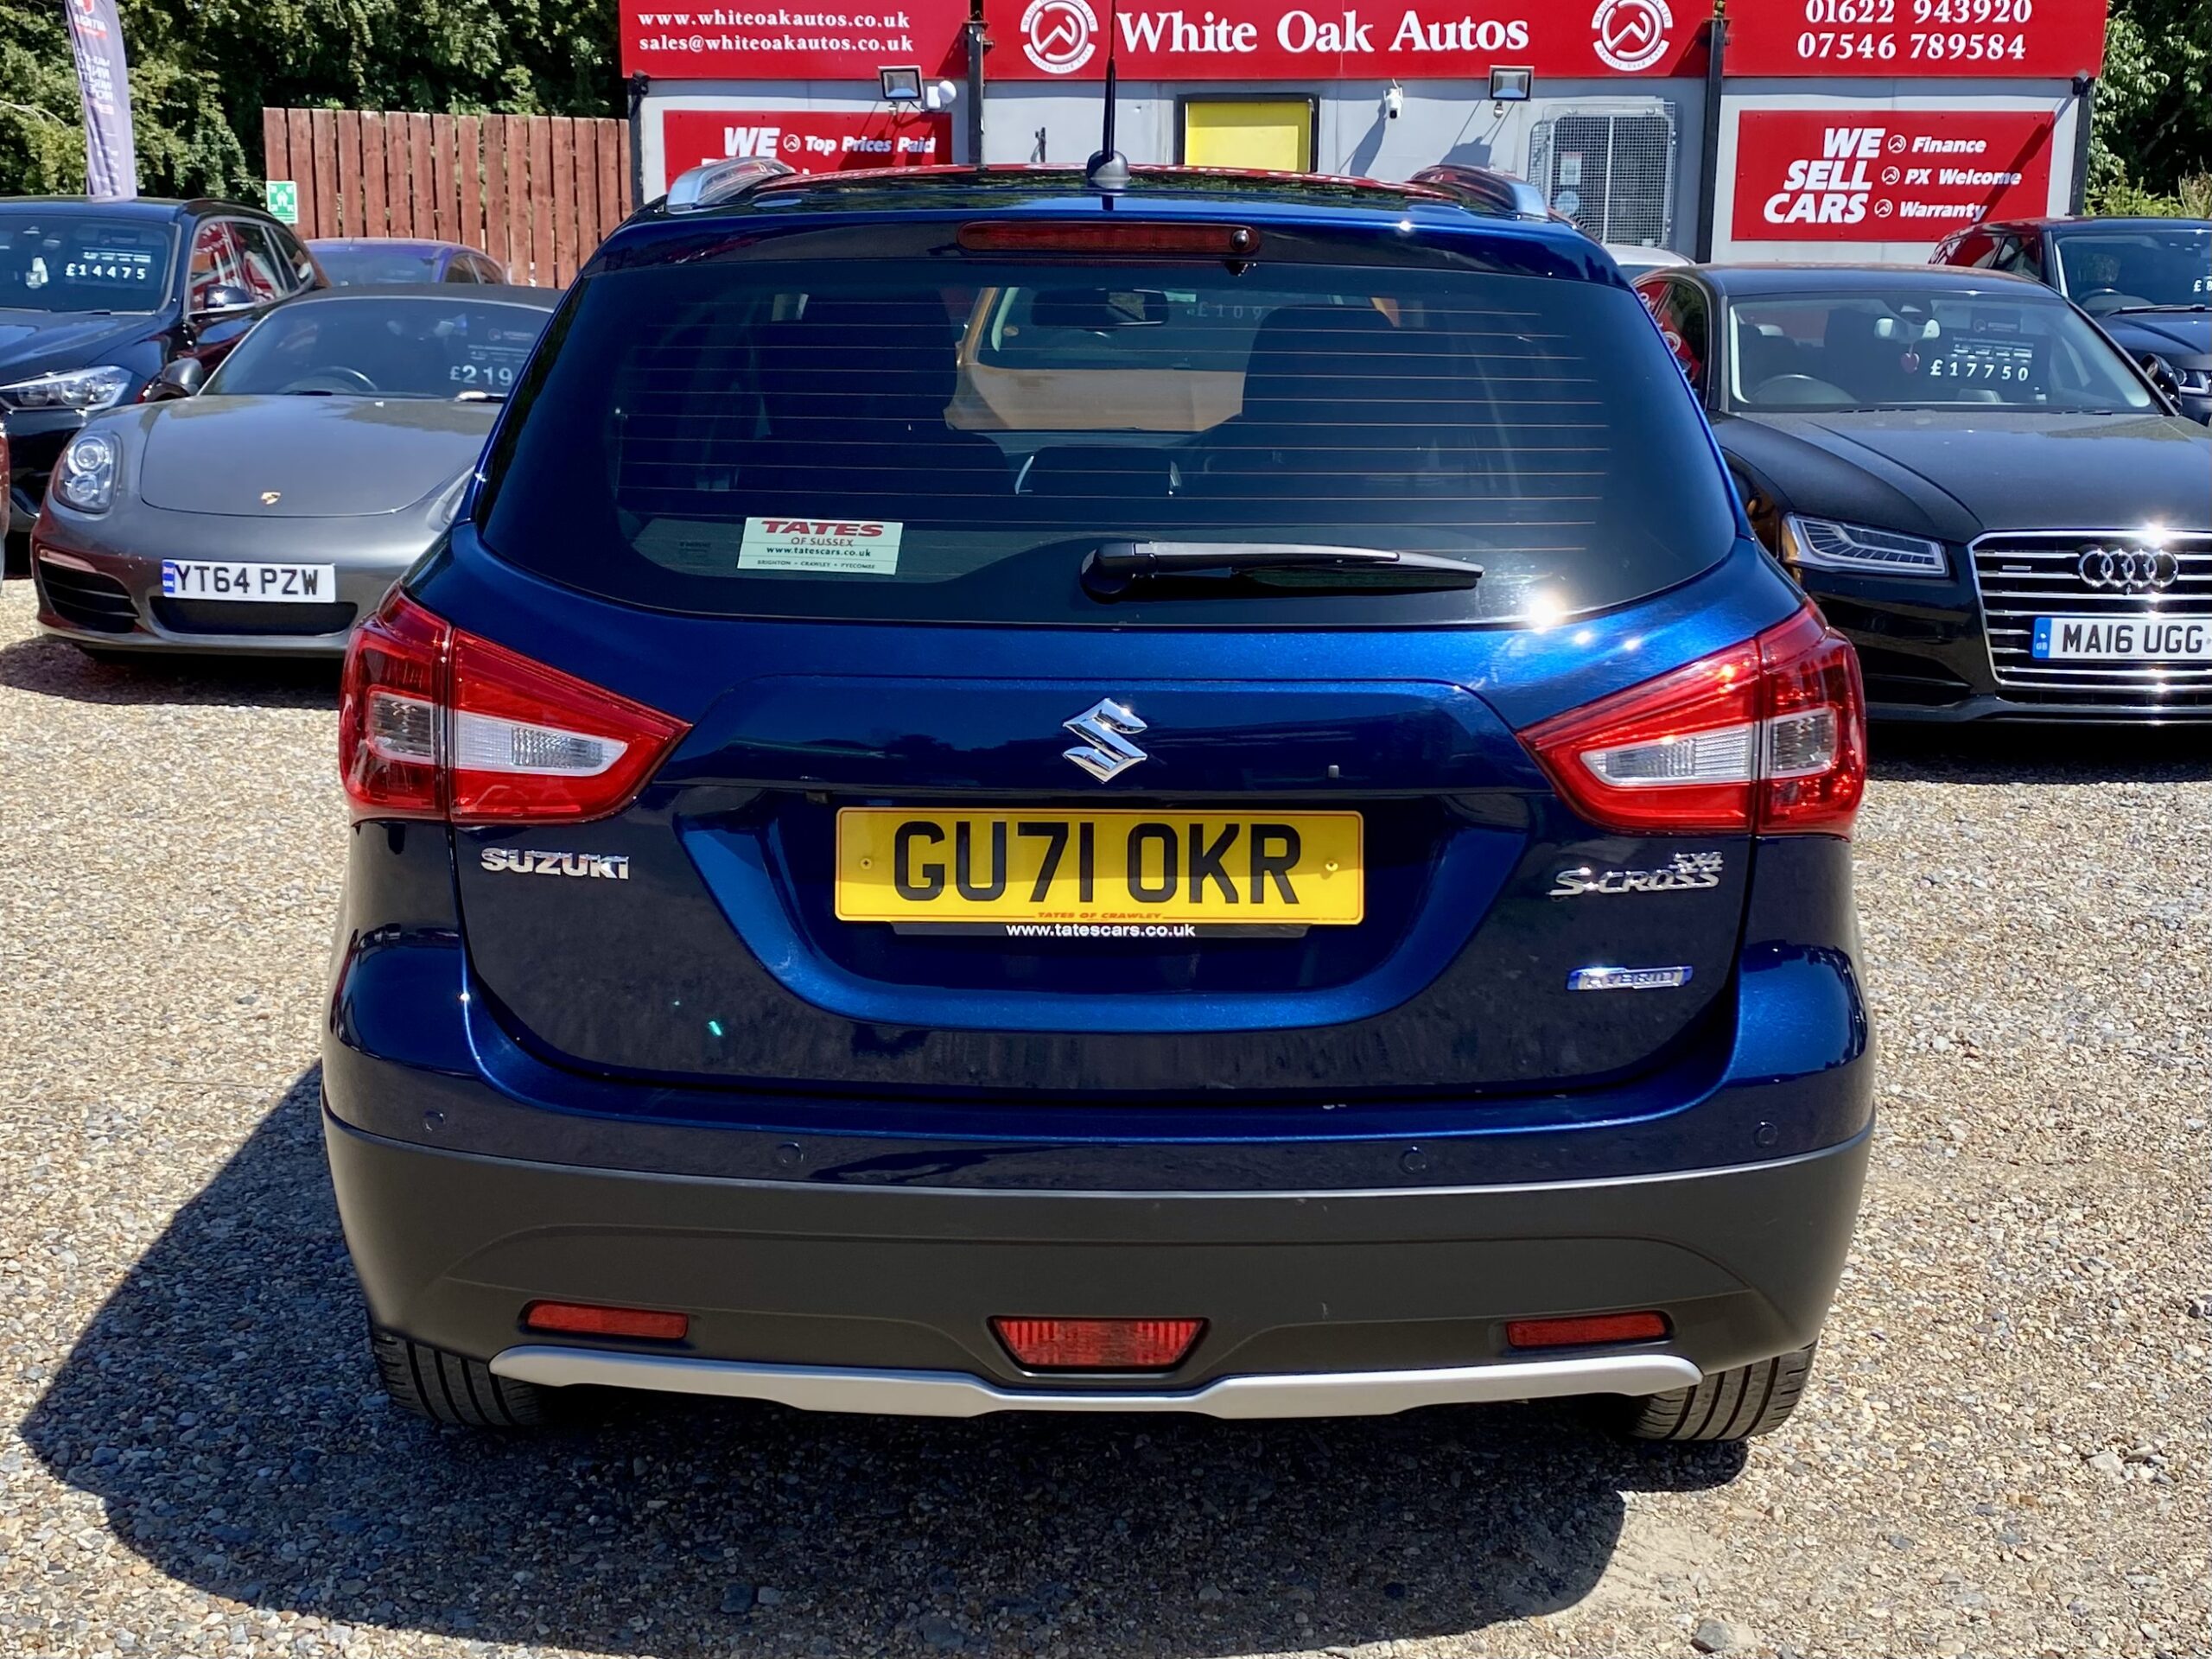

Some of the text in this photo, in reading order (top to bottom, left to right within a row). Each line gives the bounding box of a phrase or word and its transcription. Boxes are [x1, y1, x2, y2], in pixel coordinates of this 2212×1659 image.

[638, 10, 910, 28] www.whiteoakautos.co.uk
[1805, 0, 2032, 23] 01622 943920
[1116, 10, 1529, 54] White Oak Autos
[639, 35, 913, 53] sales@whiteoakautos.co.uk
[1797, 32, 2026, 60] 07546 789584
[724, 127, 780, 157] WE
[804, 136, 937, 156] Top Prices Paid
[1823, 128, 1886, 158] WE
[1911, 137, 1986, 153] Finance
[1783, 160, 1873, 191] SELL
[1904, 168, 2023, 186] PX Welcome
[1764, 193, 1868, 224] CARS
[1900, 200, 1988, 222] Warranty
[761, 521, 884, 537] TATES
[766, 547, 871, 557] www.tatescars.co.uk
[791, 537, 854, 547] OF SUSSEX
[175, 564, 319, 595] YT64 PZW
[2062, 624, 2203, 654] MA16 UGG
[480, 847, 629, 880] SUZUKI
[893, 820, 1302, 905] GU71 OKR
[1006, 924, 1196, 938] www.tatescars.co.uk
